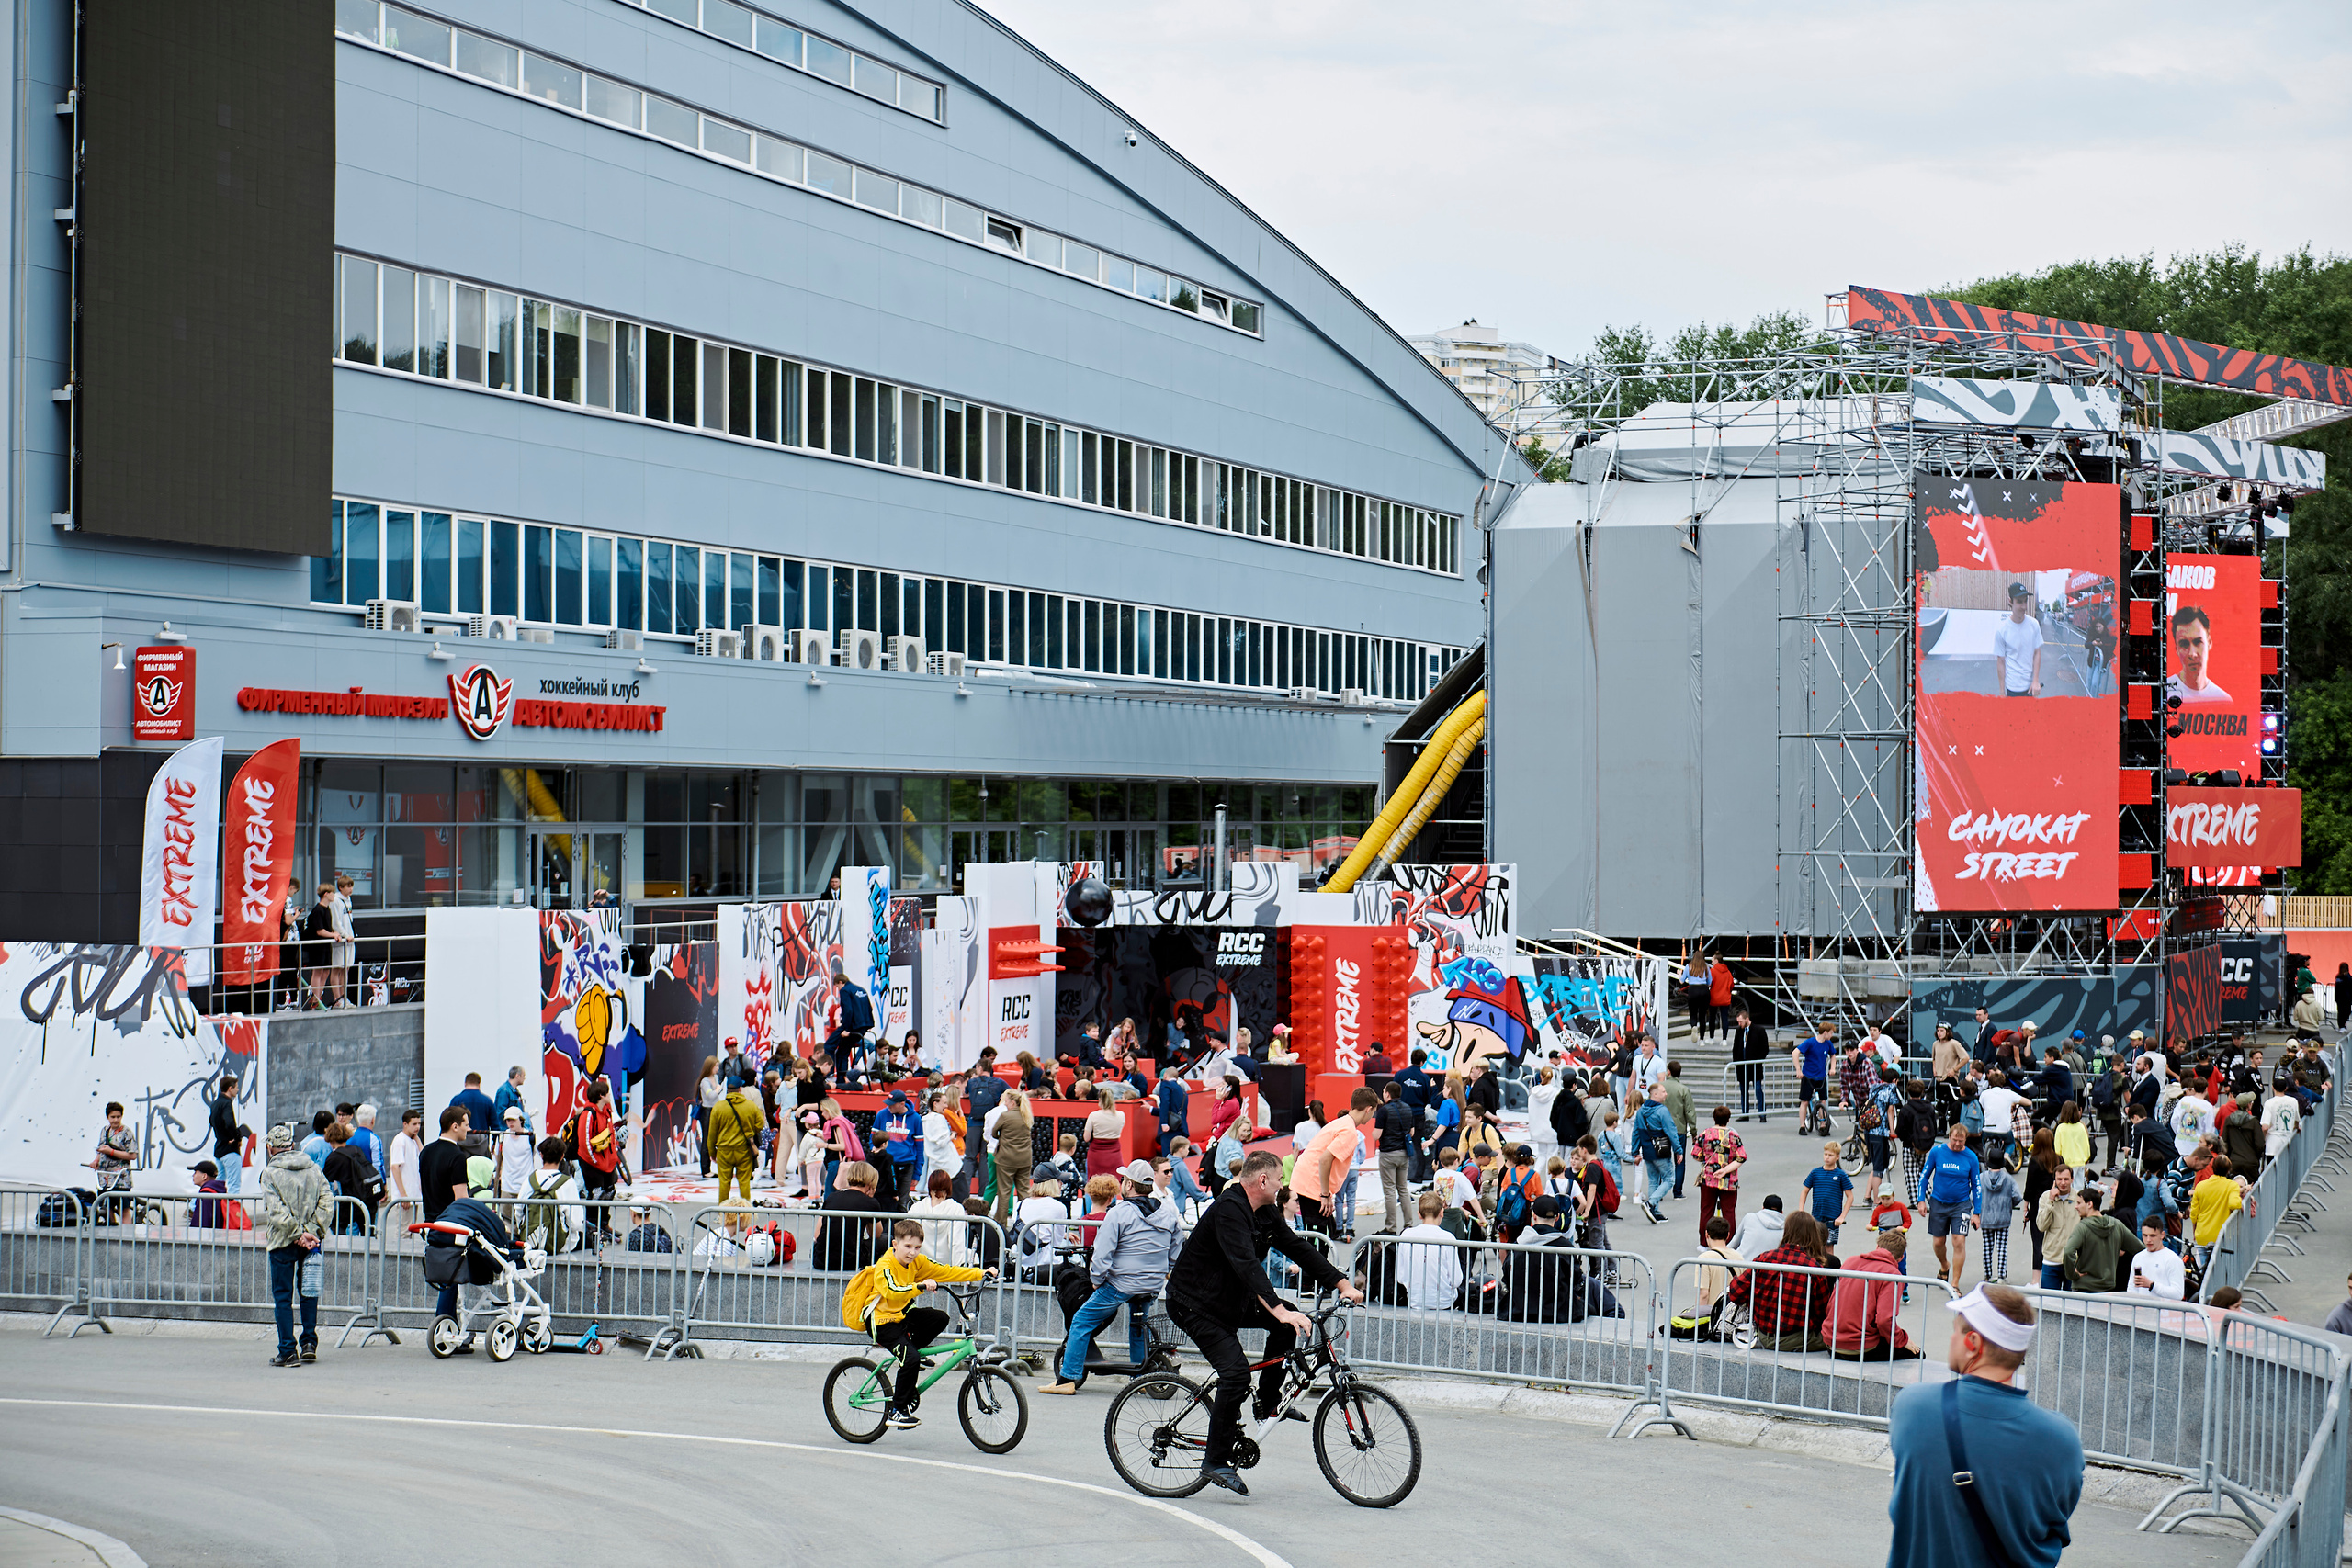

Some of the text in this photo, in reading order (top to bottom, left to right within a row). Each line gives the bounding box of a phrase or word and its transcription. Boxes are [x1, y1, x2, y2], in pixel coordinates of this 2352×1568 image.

[137, 651, 184, 661] ФИРМЕННЫЙ
[143, 663, 177, 671] МАГАЗИН
[539, 676, 639, 703] хоккейный клуб
[237, 686, 449, 719] ФИРМЕННЫЙ МАГАЗИН
[136, 719, 182, 728] АВТОМОБИЛИСТ
[512, 698, 667, 732] АВТОМОБИЛИСТ
[2177, 713, 2248, 736] МОСКВА
[166, 728, 178, 736] клуб
[1948, 807, 2092, 848] САМОКАТ
[2166, 802, 2261, 848] XTREME
[161, 775, 198, 928] EXTREME
[241, 776, 275, 924] EXTREME
[1954, 852, 2080, 882] STREET
[1217, 932, 1266, 953] RCC
[1216, 953, 1263, 967] EXTREME
[2221, 957, 2254, 982] CC
[890, 986, 909, 1008] CC
[1517, 974, 1634, 1010] EXTREME
[2221, 985, 2249, 1000] REME
[889, 1011, 907, 1024] TREME
[1001, 994, 1031, 1021] RCC
[1334, 956, 1364, 1074] EXTREME
[662, 1022, 700, 1043] EXTREME
[1000, 1024, 1029, 1043] EXTREME
